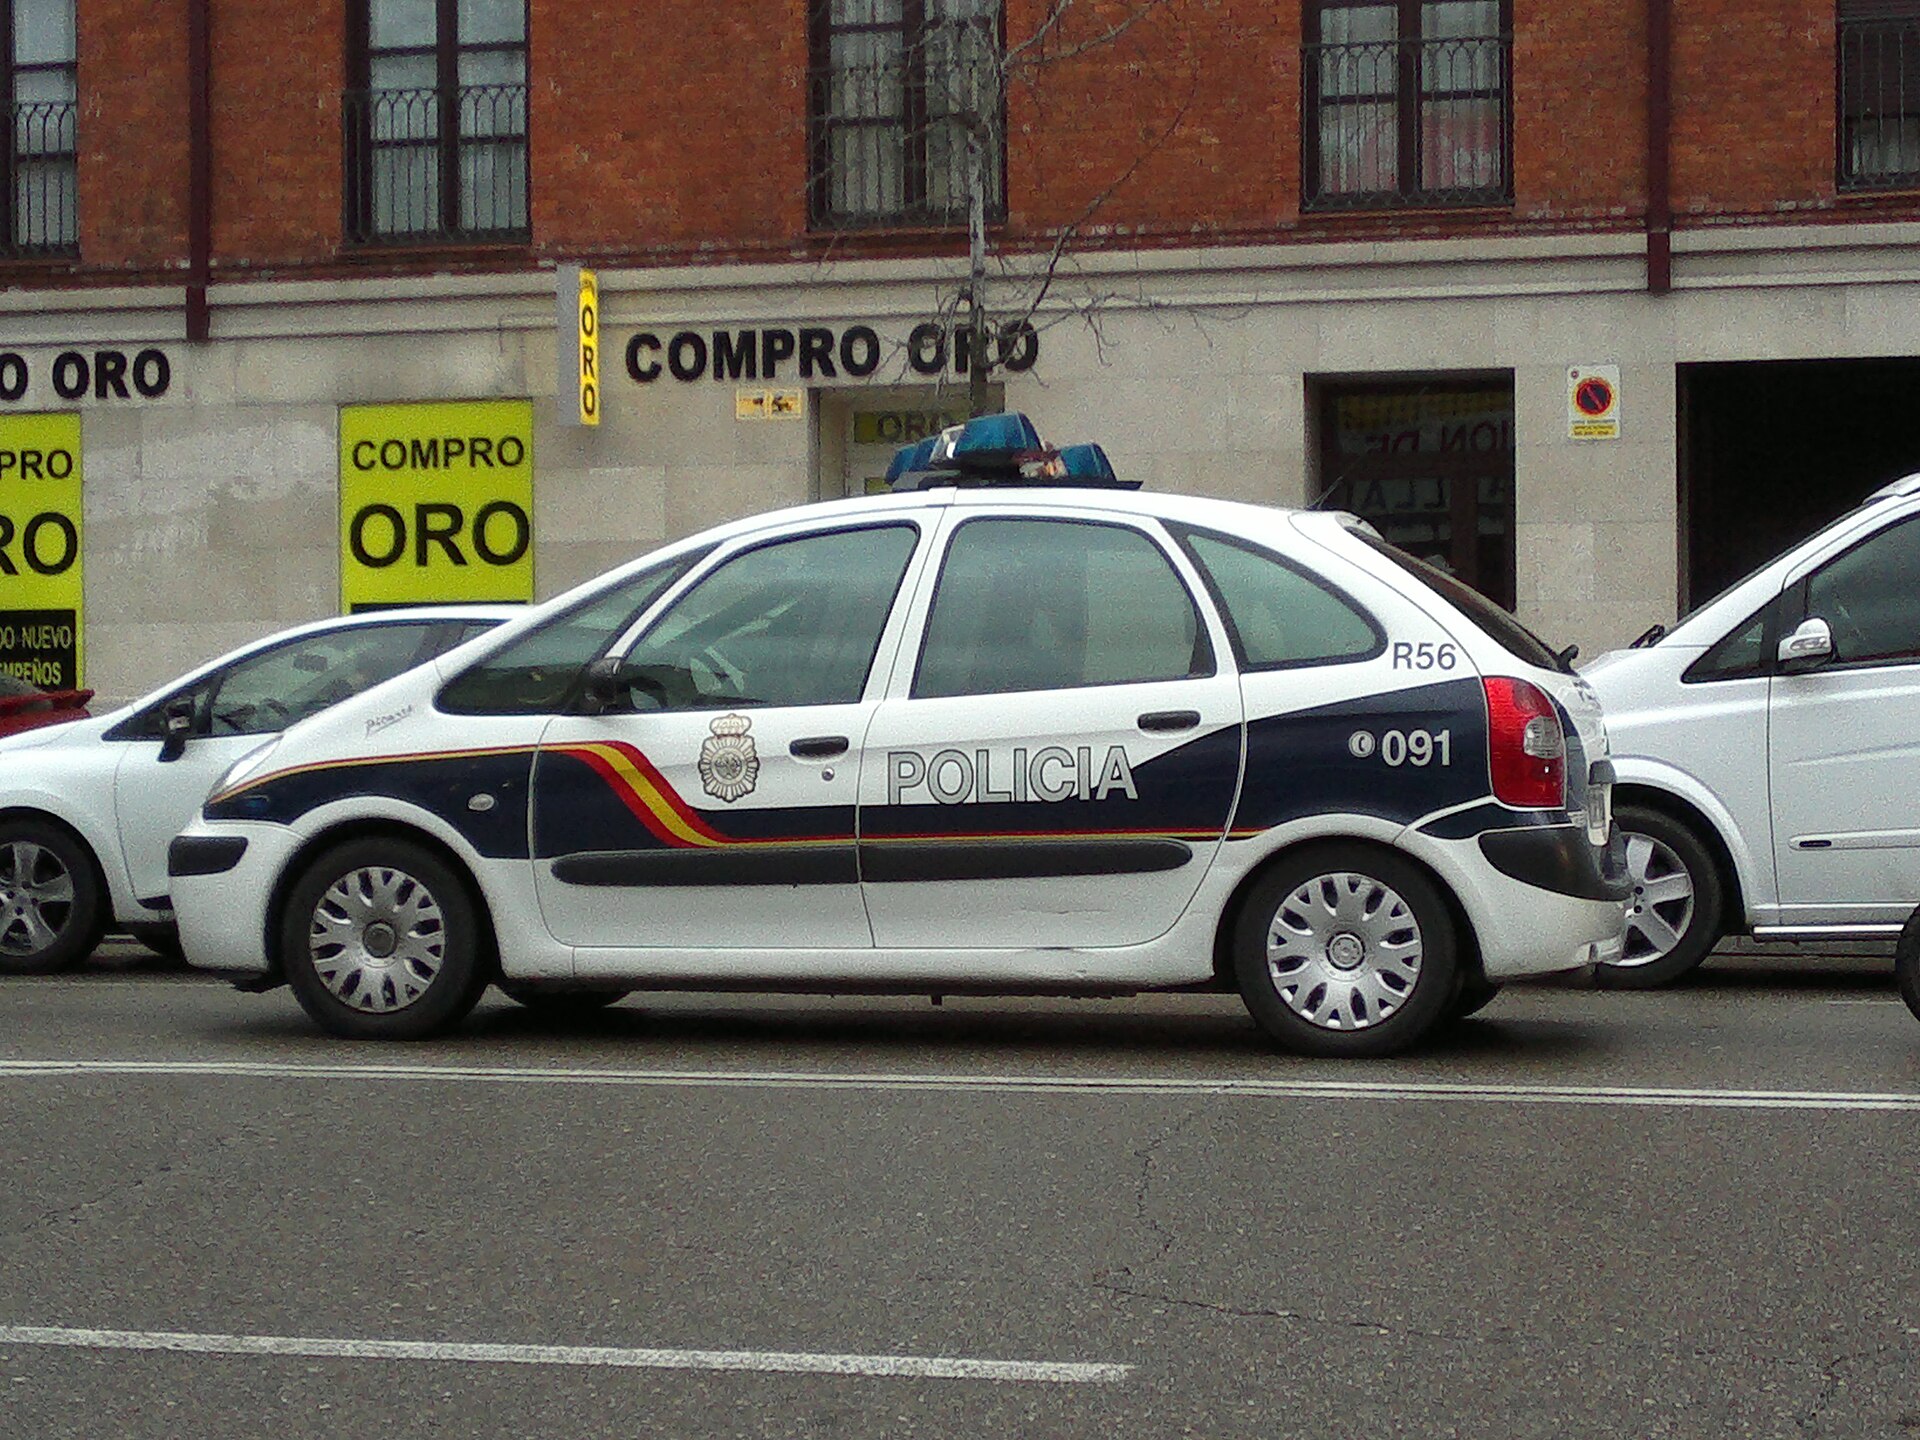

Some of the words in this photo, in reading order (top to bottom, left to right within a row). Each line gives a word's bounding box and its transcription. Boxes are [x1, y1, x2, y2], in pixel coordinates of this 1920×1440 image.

[52, 348, 170, 399] ORO
[582, 304, 595, 416] ORO
[625, 325, 881, 382] COMPRO
[352, 435, 525, 471] COMPRO
[350, 500, 530, 568] ORO
[21, 625, 72, 649] NUEVO
[1393, 642, 1456, 670] R56
[1381, 729, 1451, 766] 091
[887, 745, 1139, 805] POLICIA
